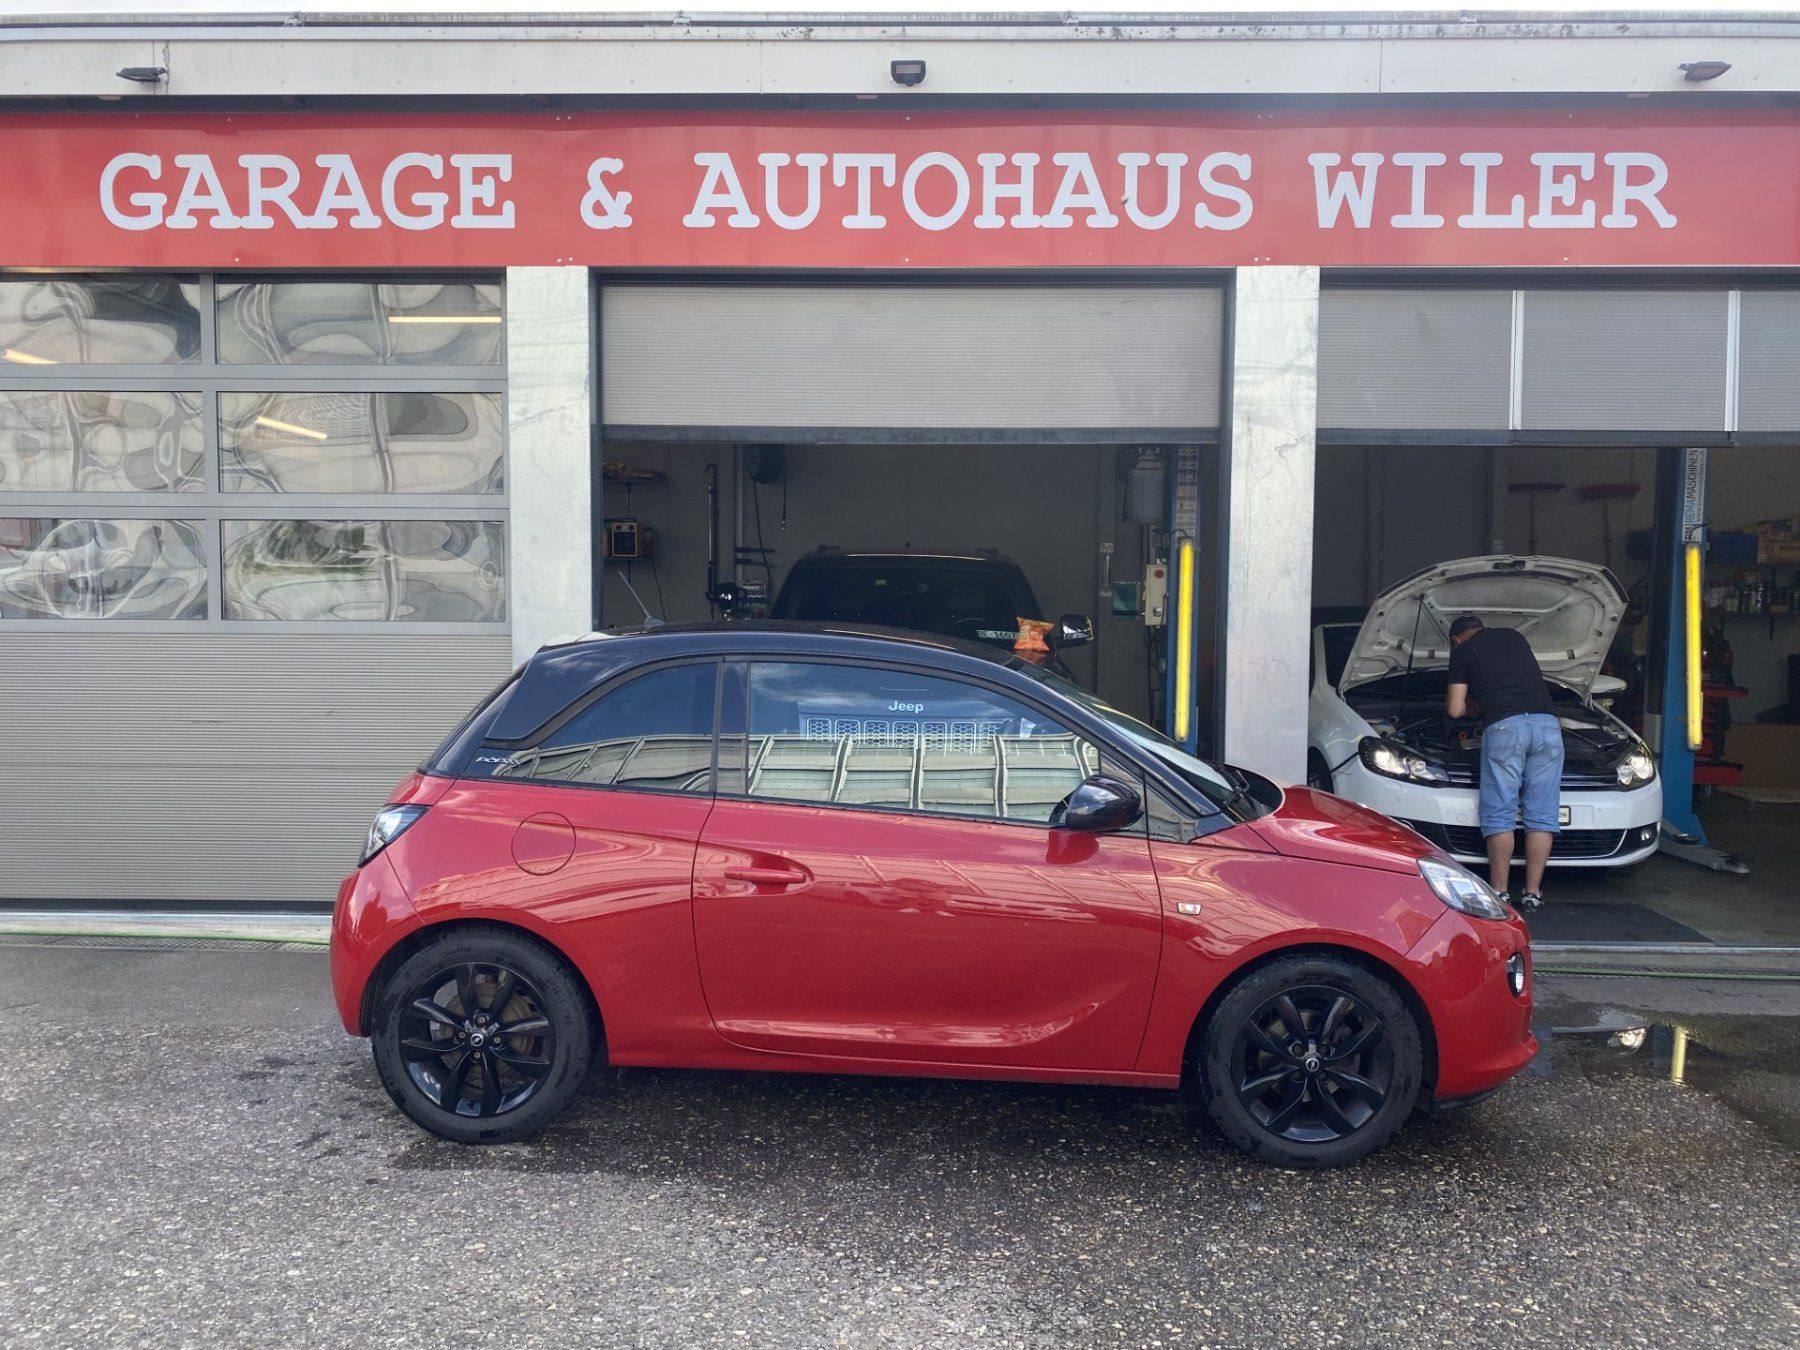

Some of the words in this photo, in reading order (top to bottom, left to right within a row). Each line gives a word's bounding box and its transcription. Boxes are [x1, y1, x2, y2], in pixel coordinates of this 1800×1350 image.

[100, 152, 516, 231] GARAGE
[580, 157, 632, 230] &
[682, 151, 1254, 231] AUTOHAUS
[1308, 152, 1678, 230] WILER
[888, 700, 924, 714] Jeep
